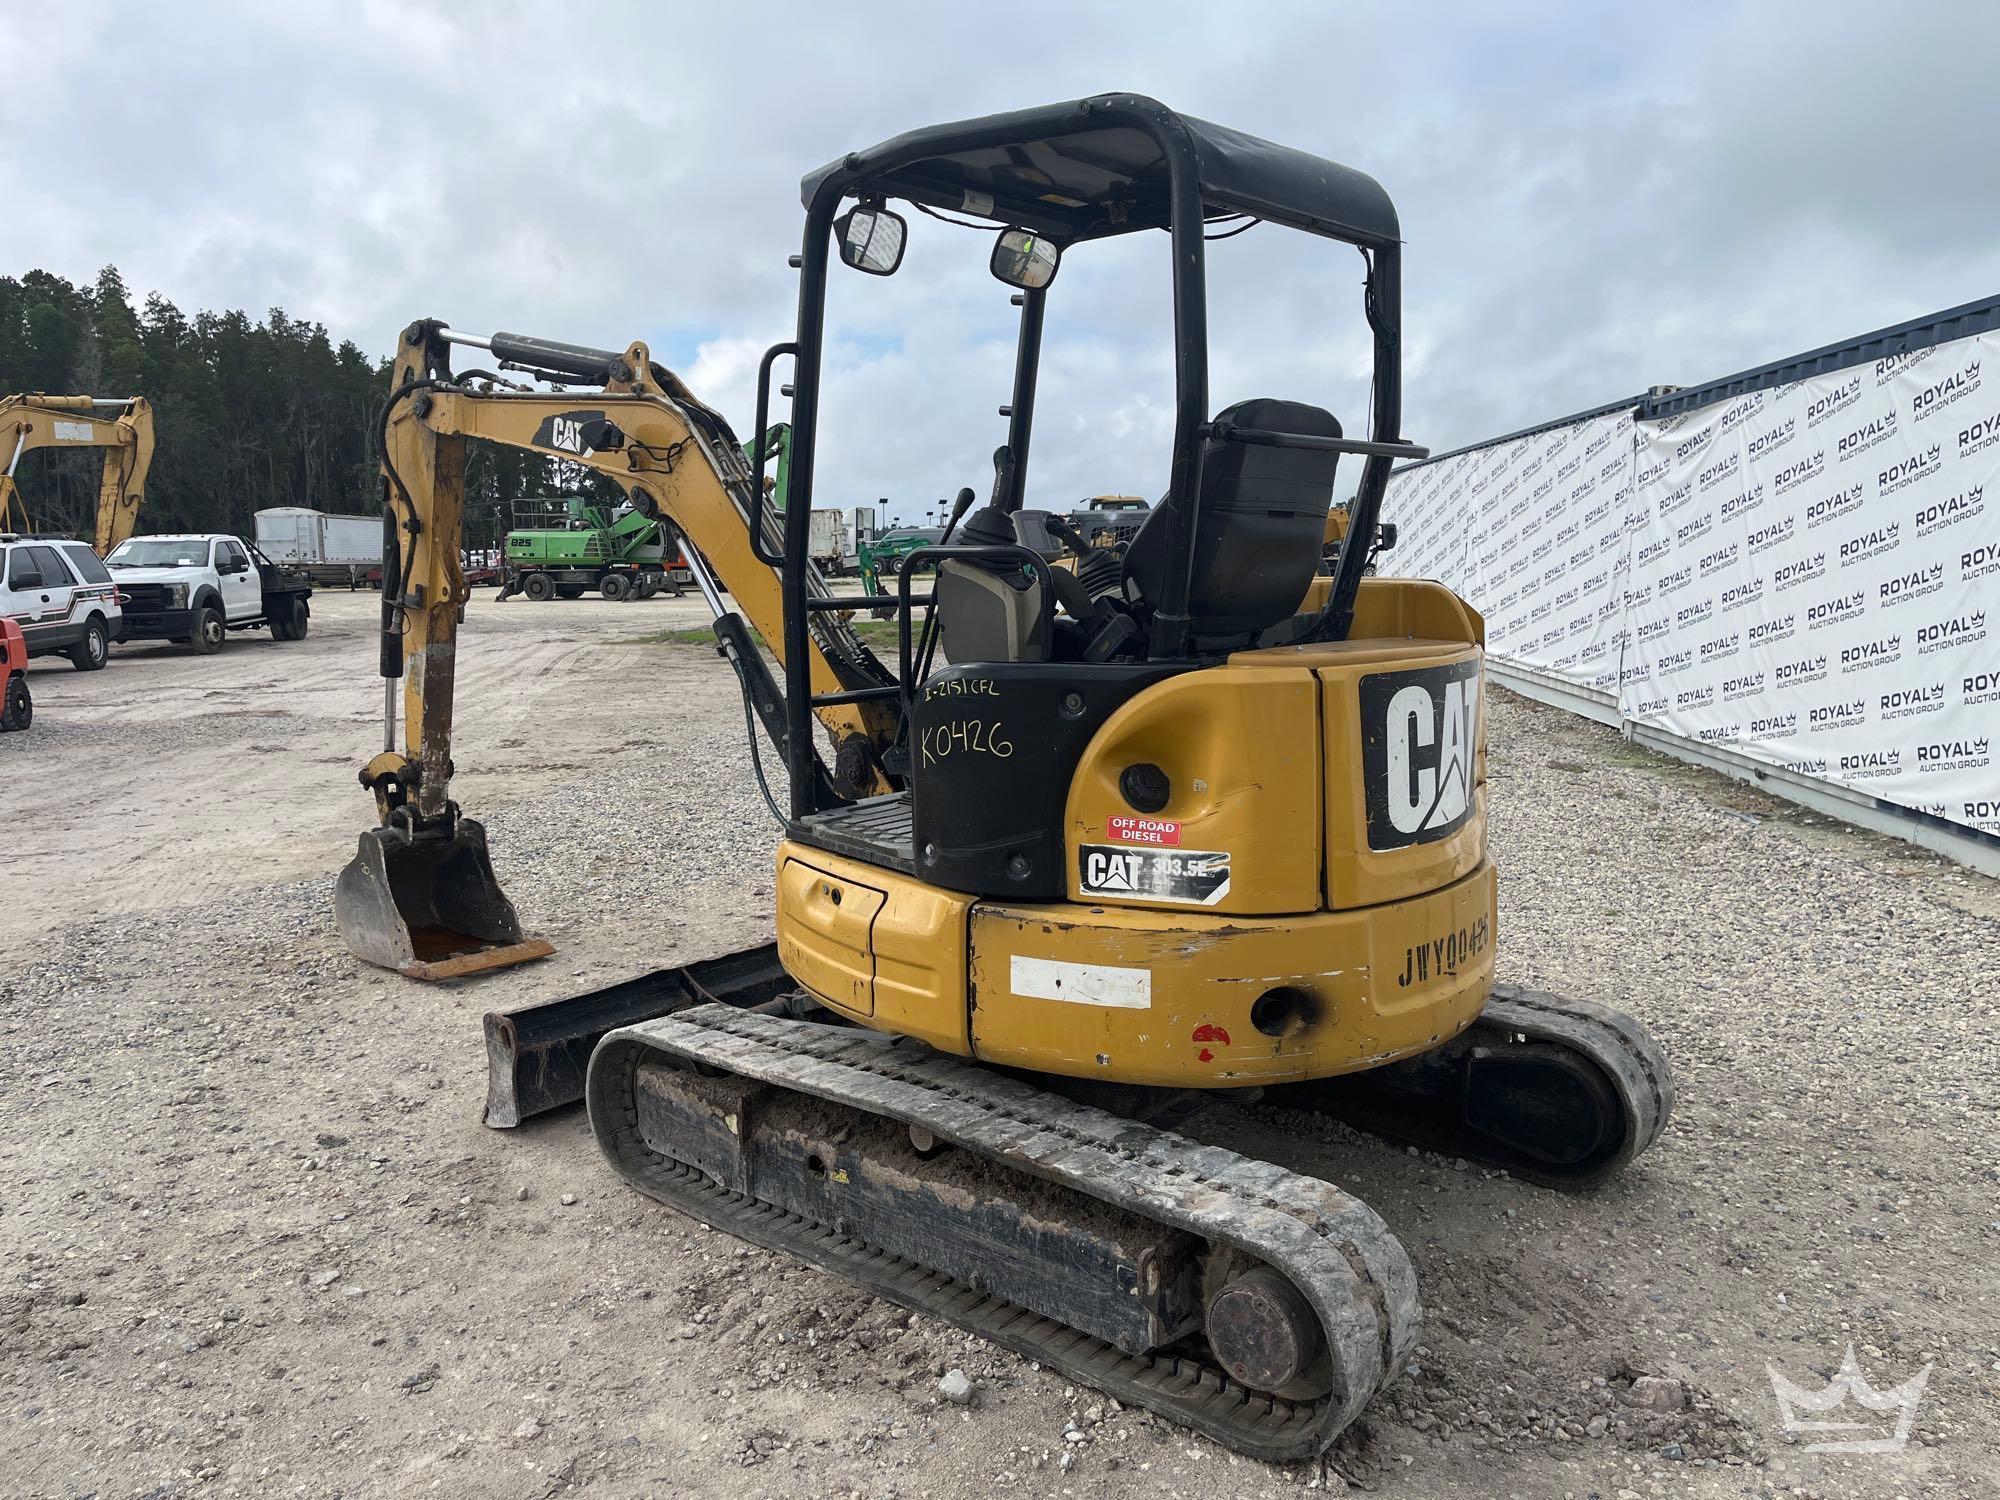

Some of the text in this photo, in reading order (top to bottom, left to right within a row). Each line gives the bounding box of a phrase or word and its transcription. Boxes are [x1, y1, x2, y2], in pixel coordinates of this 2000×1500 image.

[1876, 345, 1936, 388] AUCTION GROUP
[1807, 385, 1848, 420] ROYAL
[1912, 372, 1964, 412] ROYAL
[1914, 378, 1981, 424] AUCTION GROUP
[1722, 398, 1754, 428] ROYAL
[1808, 392, 1861, 430] AUCTION GROUP
[553, 418, 583, 452] CAT
[1585, 434, 1604, 456] ROYAL
[1676, 433, 1703, 459] ROYAL
[1748, 425, 1784, 456] ROYAL
[1838, 418, 1883, 454] ROYAL
[1839, 426, 1897, 464] AUCTION GROUP
[1960, 433, 1999, 459] AUCTION
[1749, 432, 1795, 465] AUCTION GROUP
[1558, 459, 1575, 479] ROYAL
[1601, 455, 1621, 479] ROYAL
[1637, 461, 1663, 485] ROYAL
[1699, 458, 1729, 486] ROYAL
[1774, 457, 1812, 488] ROYAL
[1878, 452, 1927, 488] ROYAL
[1572, 480, 1590, 500] ROYAL
[1775, 465, 1824, 497] AUCTION GROUP
[1879, 461, 1941, 499] AUCTION GROUP
[1659, 487, 1684, 511] ROYAL
[1721, 489, 1753, 516] ROYAL
[1806, 490, 1850, 520] ROYAL
[1915, 493, 1968, 528] ROYAL
[1585, 504, 1603, 524] ROYAL
[1721, 498, 1764, 525] AUCTION GROUP
[1807, 498, 1865, 531] AUCTION GROUP
[1916, 503, 1985, 539] AUCTION GROUP
[1557, 524, 1574, 542] ROYAL
[1600, 526, 1619, 549] ROYAL
[1677, 517, 1703, 540] ROYAL
[1748, 521, 1784, 548] ROYAL
[511, 538, 532, 546] 825
[1638, 540, 1663, 561] ROYAL
[1748, 529, 1795, 557] AUCTION GROUP
[1840, 528, 1884, 558] ROYAL
[1840, 539, 1898, 569] AUCTION GROUP
[1571, 548, 1589, 566] ROYAL
[1699, 547, 1729, 570] ROYAL
[1584, 573, 1602, 591] ROYAL
[1658, 569, 1684, 590] ROYAL
[1774, 558, 1811, 584] ROYAL
[1775, 568, 1824, 593] AUCTION GROUP
[1721, 581, 1753, 605] ROYAL
[1880, 569, 1929, 598] ROYAL
[1880, 580, 1943, 609] AUCTION GROUP
[1556, 590, 1572, 605] ROYAL
[1722, 592, 1764, 614] AUCTION GROUP
[1808, 596, 1852, 621] ROYAL
[1569, 615, 1587, 631] ROYAL
[1677, 602, 1704, 622] ROYAL
[1808, 607, 1866, 631] AUCTION GROUP
[1637, 619, 1662, 638] ROYAL
[1748, 618, 1784, 640] ROYAL
[1749, 628, 1796, 649] AUCTION GROUP
[1917, 616, 1970, 644] ROYAL
[1581, 641, 1600, 658] ROYAL
[1700, 636, 1730, 656] ROYAL
[1841, 640, 1885, 664] ROYAL
[1918, 629, 1988, 656] AUCTION GROUP
[1658, 652, 1684, 669] ROYAL
[1775, 659, 1813, 680] ROYAL
[1841, 652, 1899, 675] AUCTION GROUP
[1596, 669, 1615, 686] ROYAL
[1722, 674, 1754, 693] ROYAL
[1776, 671, 1826, 690] AUCTION GROUP
[1677, 688, 1704, 704] ROYAL
[1723, 685, 1765, 702] AUCTION GROUP
[1880, 686, 1930, 710] ROYAL
[1810, 702, 1852, 722] ROYAL
[1880, 701, 1944, 721] AUCTION GROUP
[1700, 726, 1730, 740] ROYAL
[1750, 715, 1786, 732] ROYAL
[1751, 728, 1797, 742] AUCTION GROUP
[1810, 716, 1866, 733] AUCTION GROUP
[1387, 676, 1478, 833] CAT
[1840, 752, 1886, 769] ROYAL
[1917, 740, 1973, 761] ROYAL
[1842, 766, 1901, 780] AUCTION GROUP
[1918, 757, 1991, 773] AUCTION GROUP
[1112, 818, 1175, 832] OFF ROAD
[1122, 829, 1164, 843] DIESEL
[1088, 852, 1143, 890] CAT
